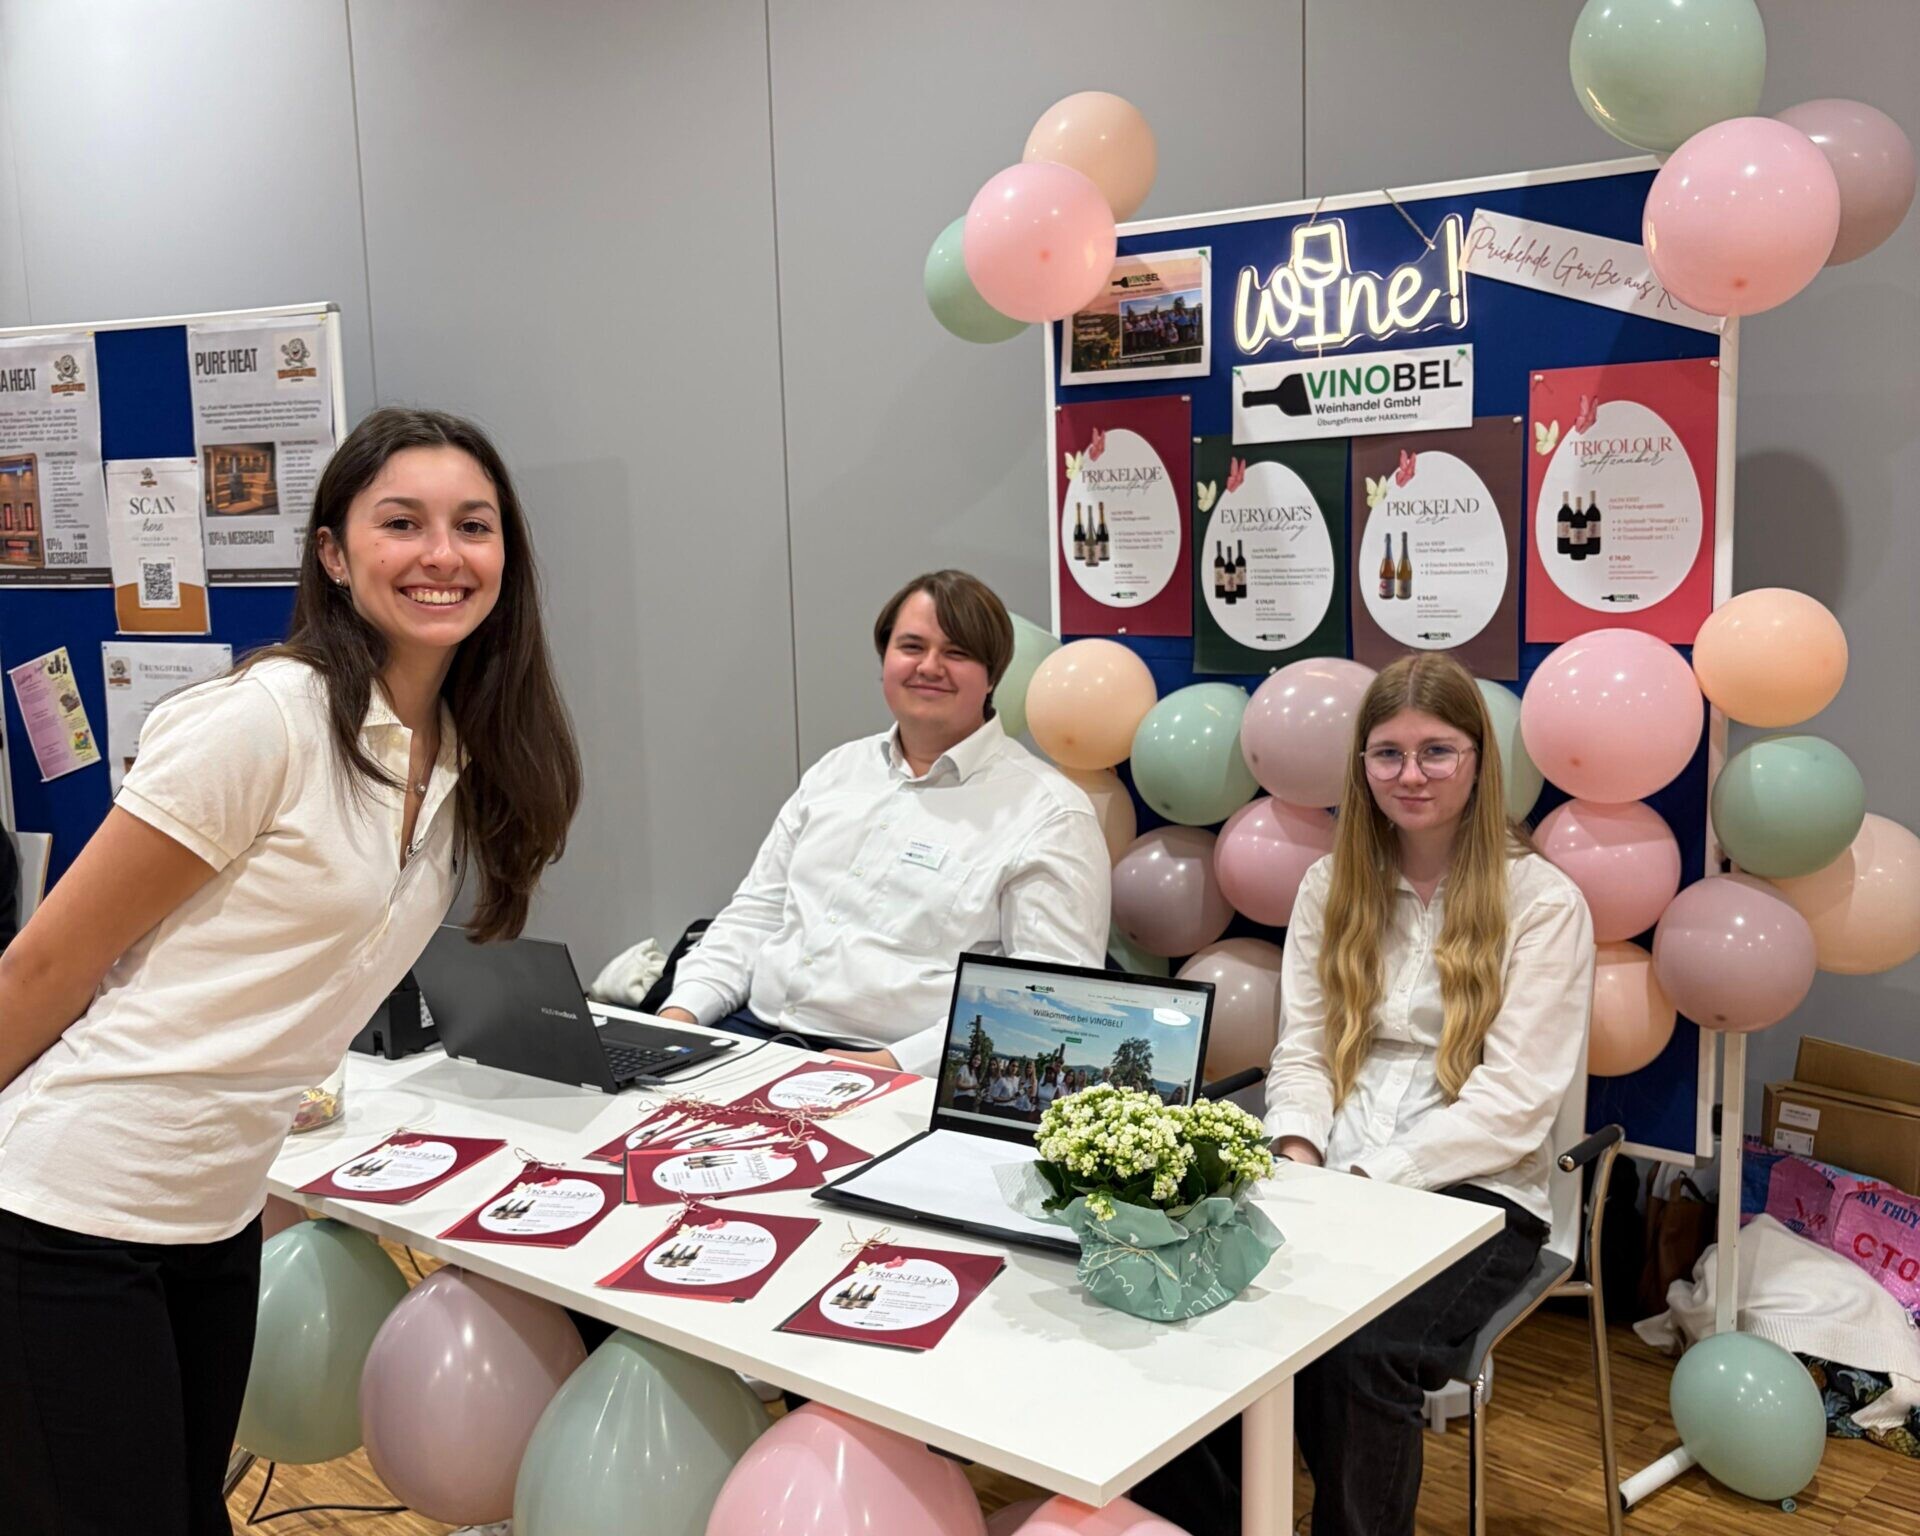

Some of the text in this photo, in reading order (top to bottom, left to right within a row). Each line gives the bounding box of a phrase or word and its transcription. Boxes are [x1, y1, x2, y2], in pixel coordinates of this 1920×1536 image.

[1467, 226, 1550, 274] Prickelnde
[1553, 247, 1621, 289] Grüße
[1624, 277, 1655, 300] aus
[195, 348, 258, 376] PURE HEAT
[9, 368, 36, 392] HEAT
[1307, 359, 1463, 399] VINOBEL
[1315, 396, 1421, 414] Weinhandel GmbH
[1317, 416, 1363, 426] Übungsfirma
[1570, 436, 1673, 457] TRICOLOUR
[1082, 466, 1162, 484] PRICKELNDE
[129, 496, 176, 515] SCAN
[1221, 505, 1313, 524] EVERYONE'S
[1386, 498, 1480, 517] PRICKELND
[142, 518, 164, 532] here
[1033, 1009, 1123, 1029] Willkommen bei VINOBEL!
